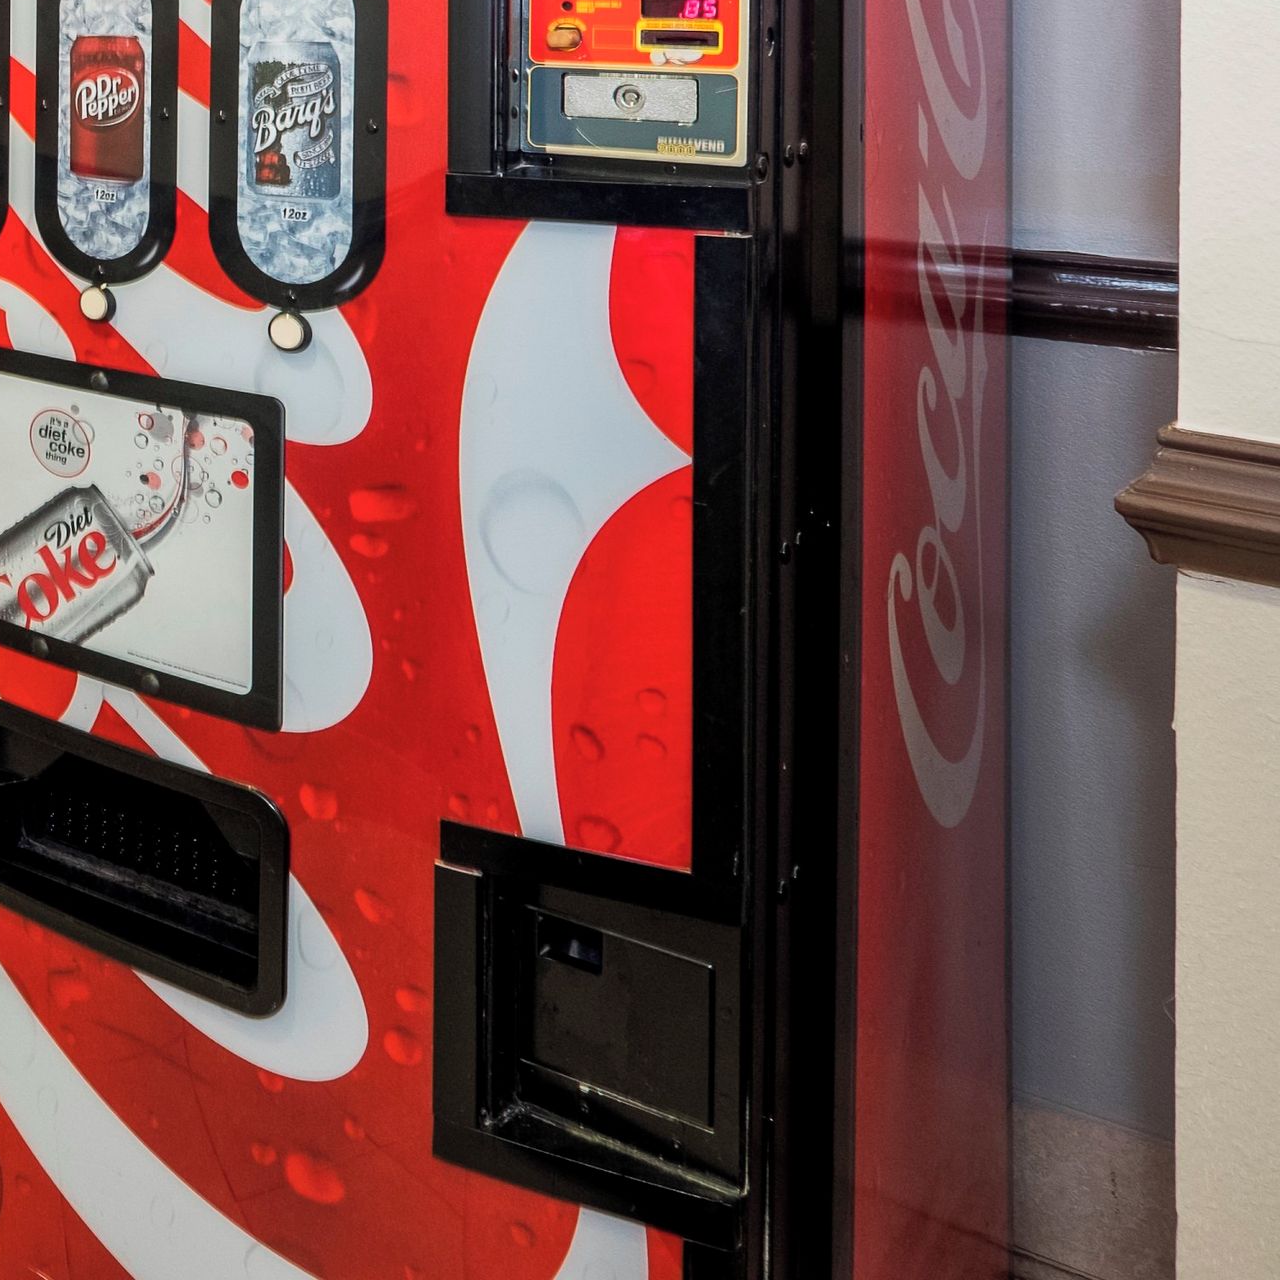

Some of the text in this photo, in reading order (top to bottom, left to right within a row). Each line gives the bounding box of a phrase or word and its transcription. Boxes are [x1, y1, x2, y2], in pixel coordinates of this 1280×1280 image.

[97, 74, 121, 99] Dr
[82, 79, 135, 120] Pepper
[253, 87, 336, 153] Barq's
[95, 189, 116, 201] 12oz
[283, 207, 308, 220] 12oz
[39, 425, 66, 443] diet
[46, 451, 67, 465] thing
[49, 441, 85, 458] coke
[44, 505, 92, 548] Diet
